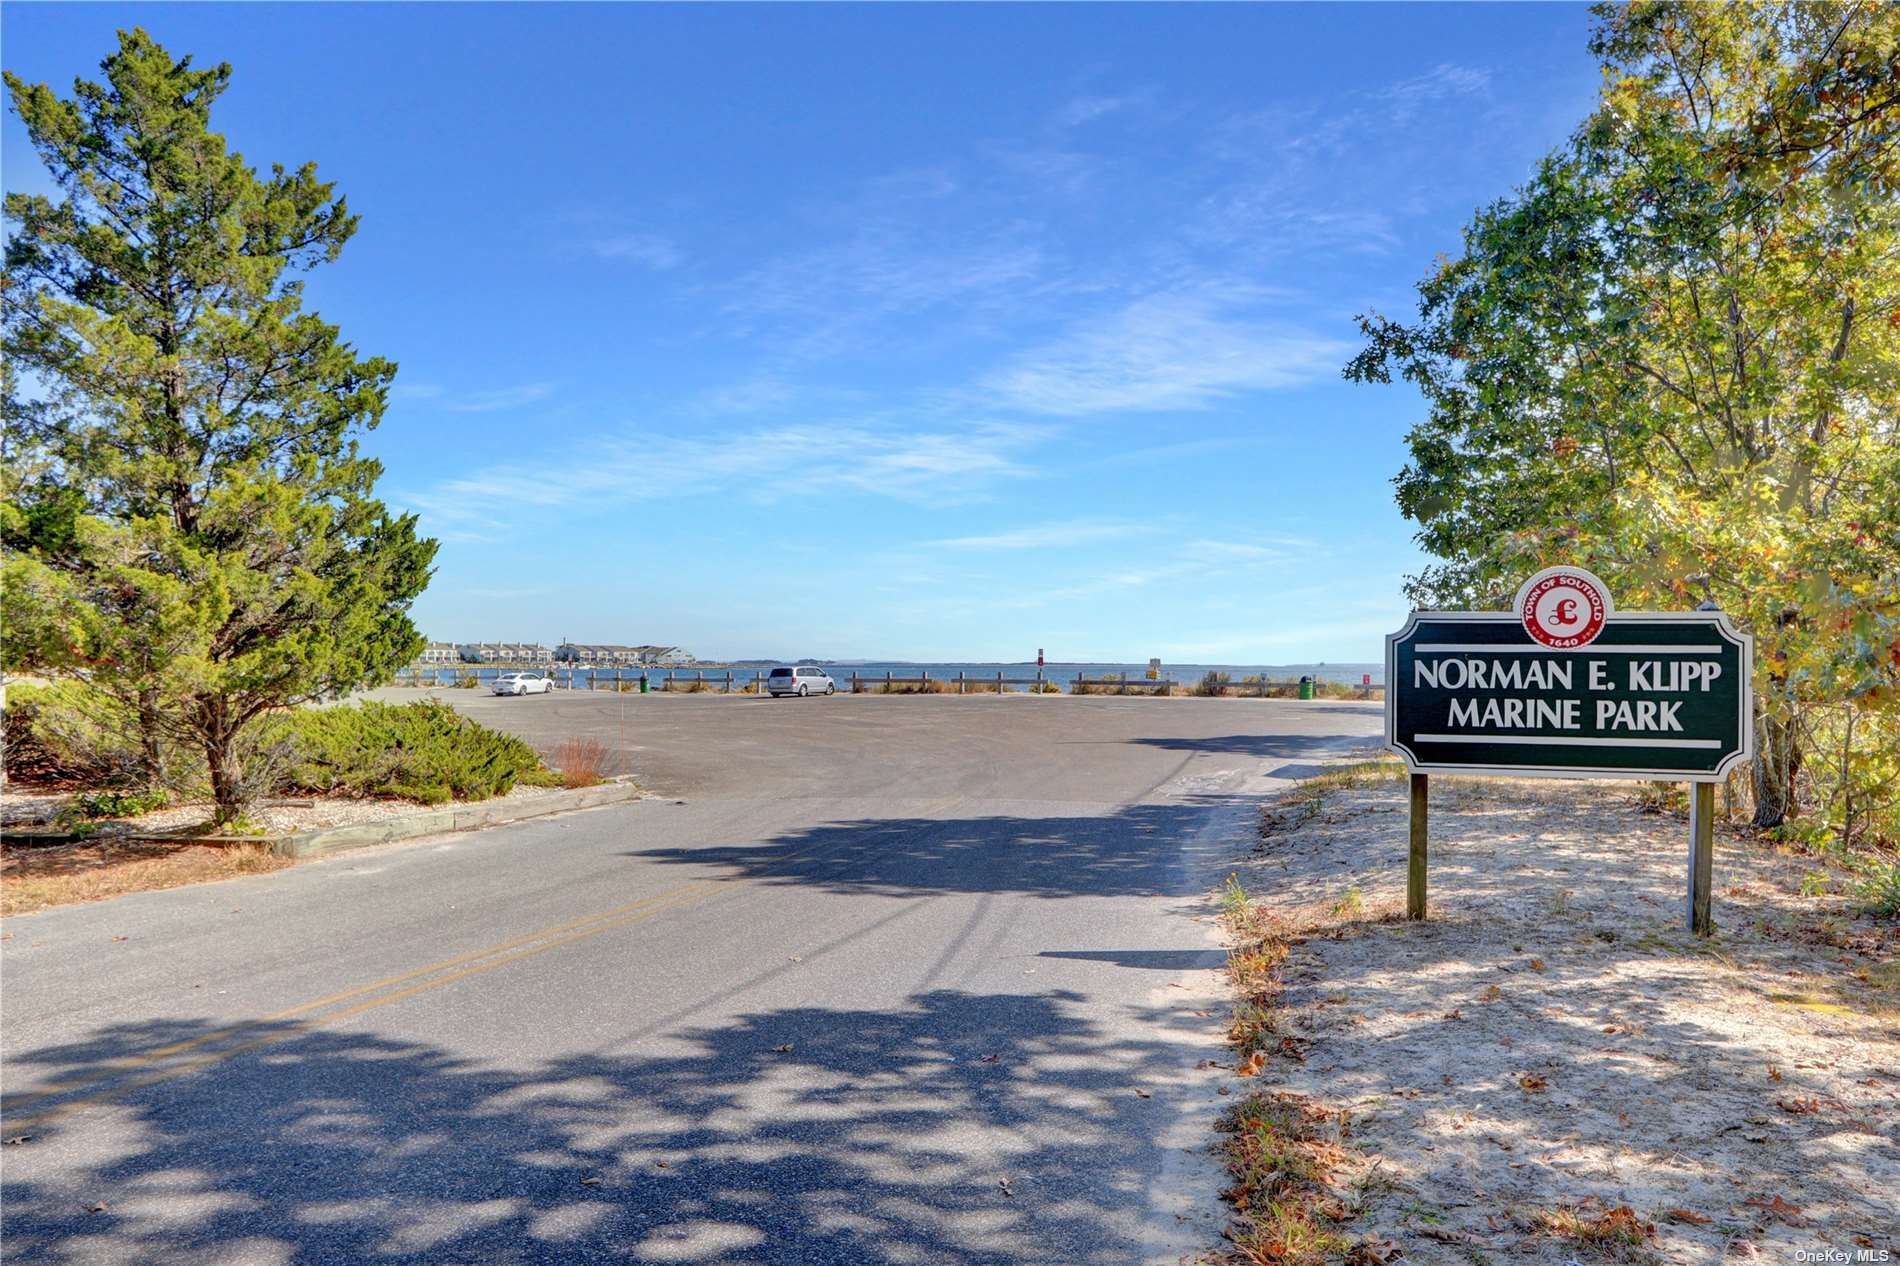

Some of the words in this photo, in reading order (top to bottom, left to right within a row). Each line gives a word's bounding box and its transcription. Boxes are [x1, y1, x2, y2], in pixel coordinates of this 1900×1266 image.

[1525, 588, 1542, 621] TOWN
[1541, 579, 1556, 590] OF
[1560, 577, 1602, 621] SOUTHOLD
[1549, 638, 1579, 647] 1640
[1414, 659, 1572, 690] NORMAN
[1588, 660, 1615, 690] E.
[1629, 660, 1723, 692] KLIPP
[1447, 697, 1581, 730] MARINE
[1595, 700, 1684, 732] PARK
